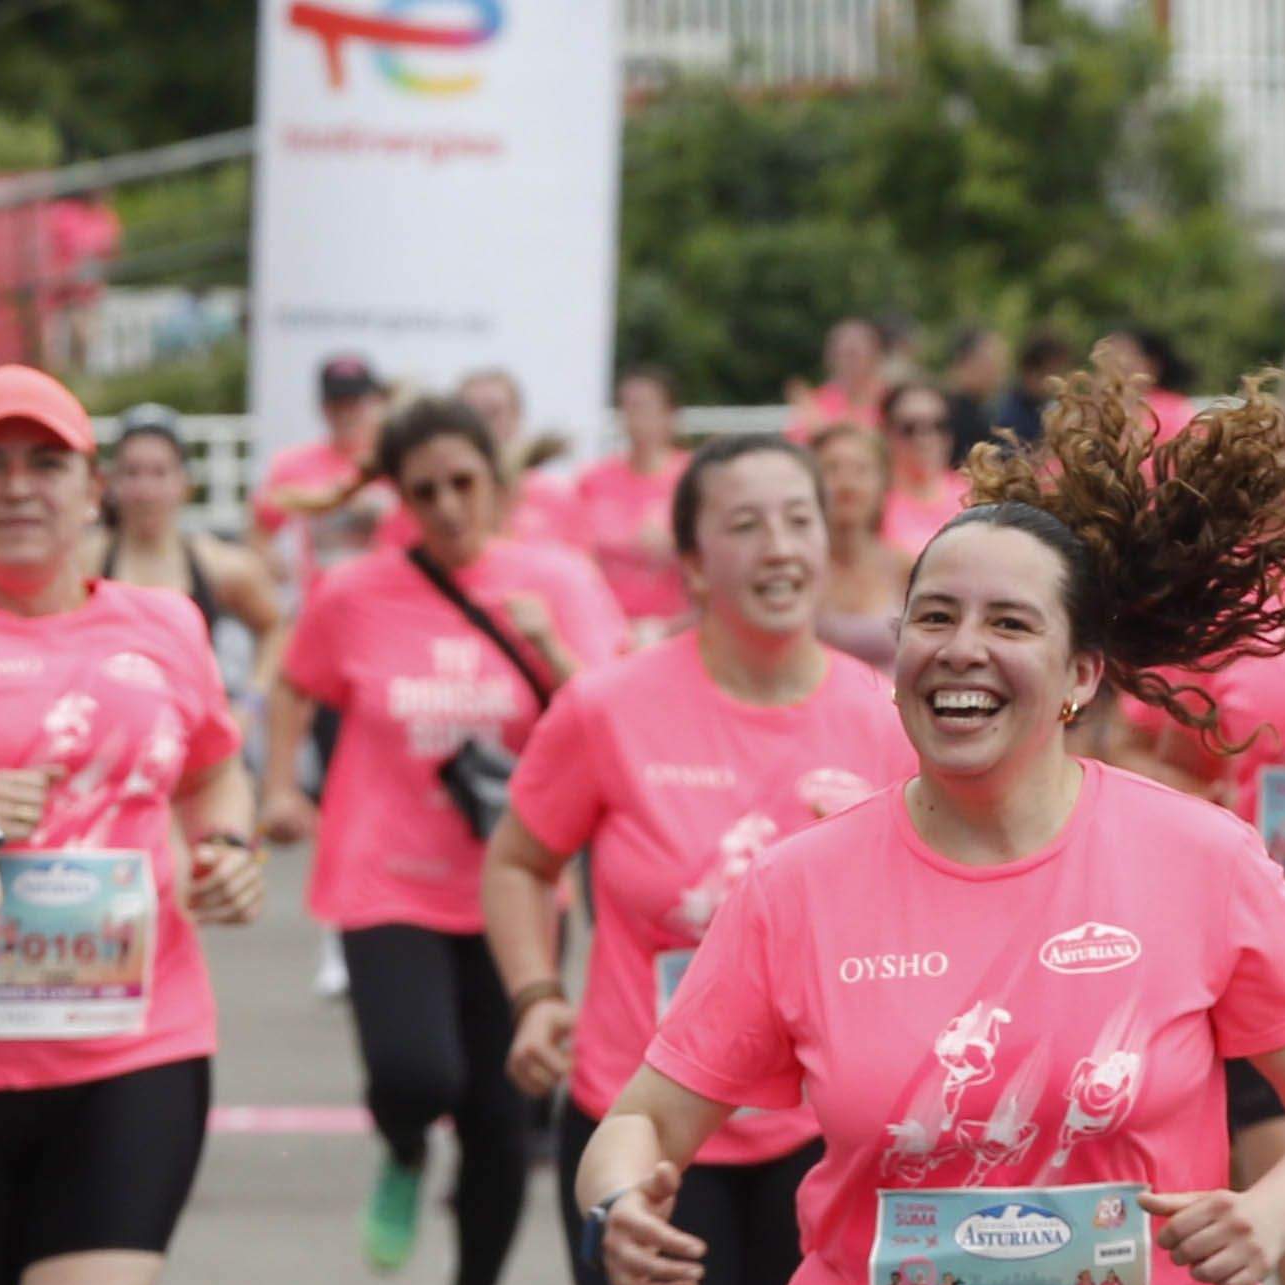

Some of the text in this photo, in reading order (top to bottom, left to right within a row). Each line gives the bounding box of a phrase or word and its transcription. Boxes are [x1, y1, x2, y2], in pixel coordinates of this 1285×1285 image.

[23, 932, 97, 965] 016
[839, 951, 949, 983] OYSHO
[963, 1222, 1063, 1246] ASTURIANA
